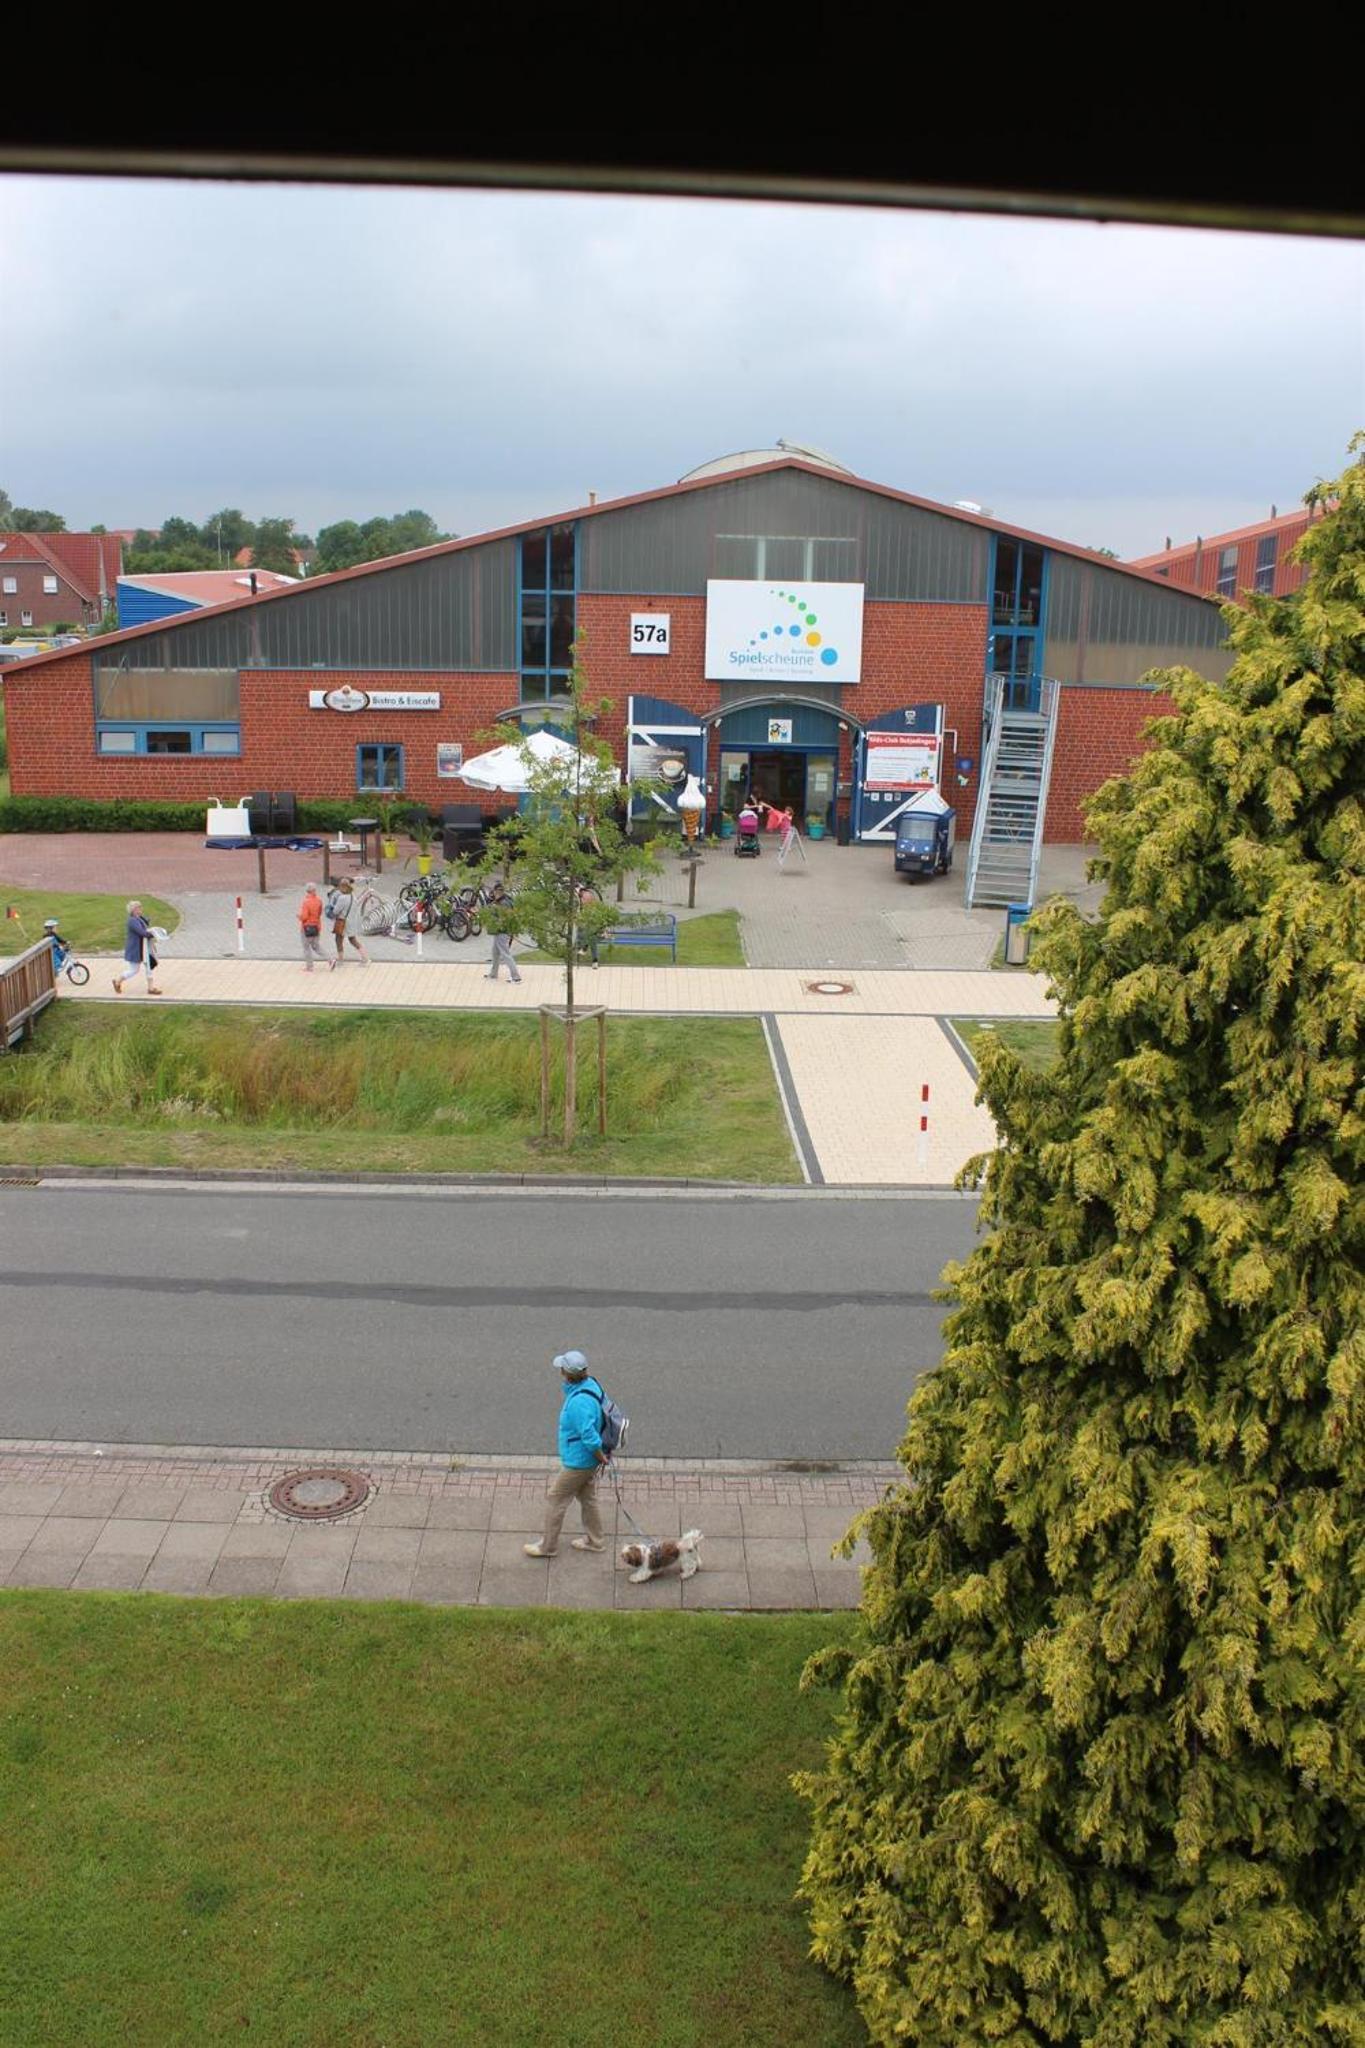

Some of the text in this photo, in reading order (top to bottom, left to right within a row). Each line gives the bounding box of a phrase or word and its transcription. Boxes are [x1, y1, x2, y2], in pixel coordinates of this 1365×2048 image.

[633, 624, 667, 643] 57a
[728, 648, 815, 667] Spielscheune
[372, 696, 397, 705] Bistro
[398, 696, 405, 705] &
